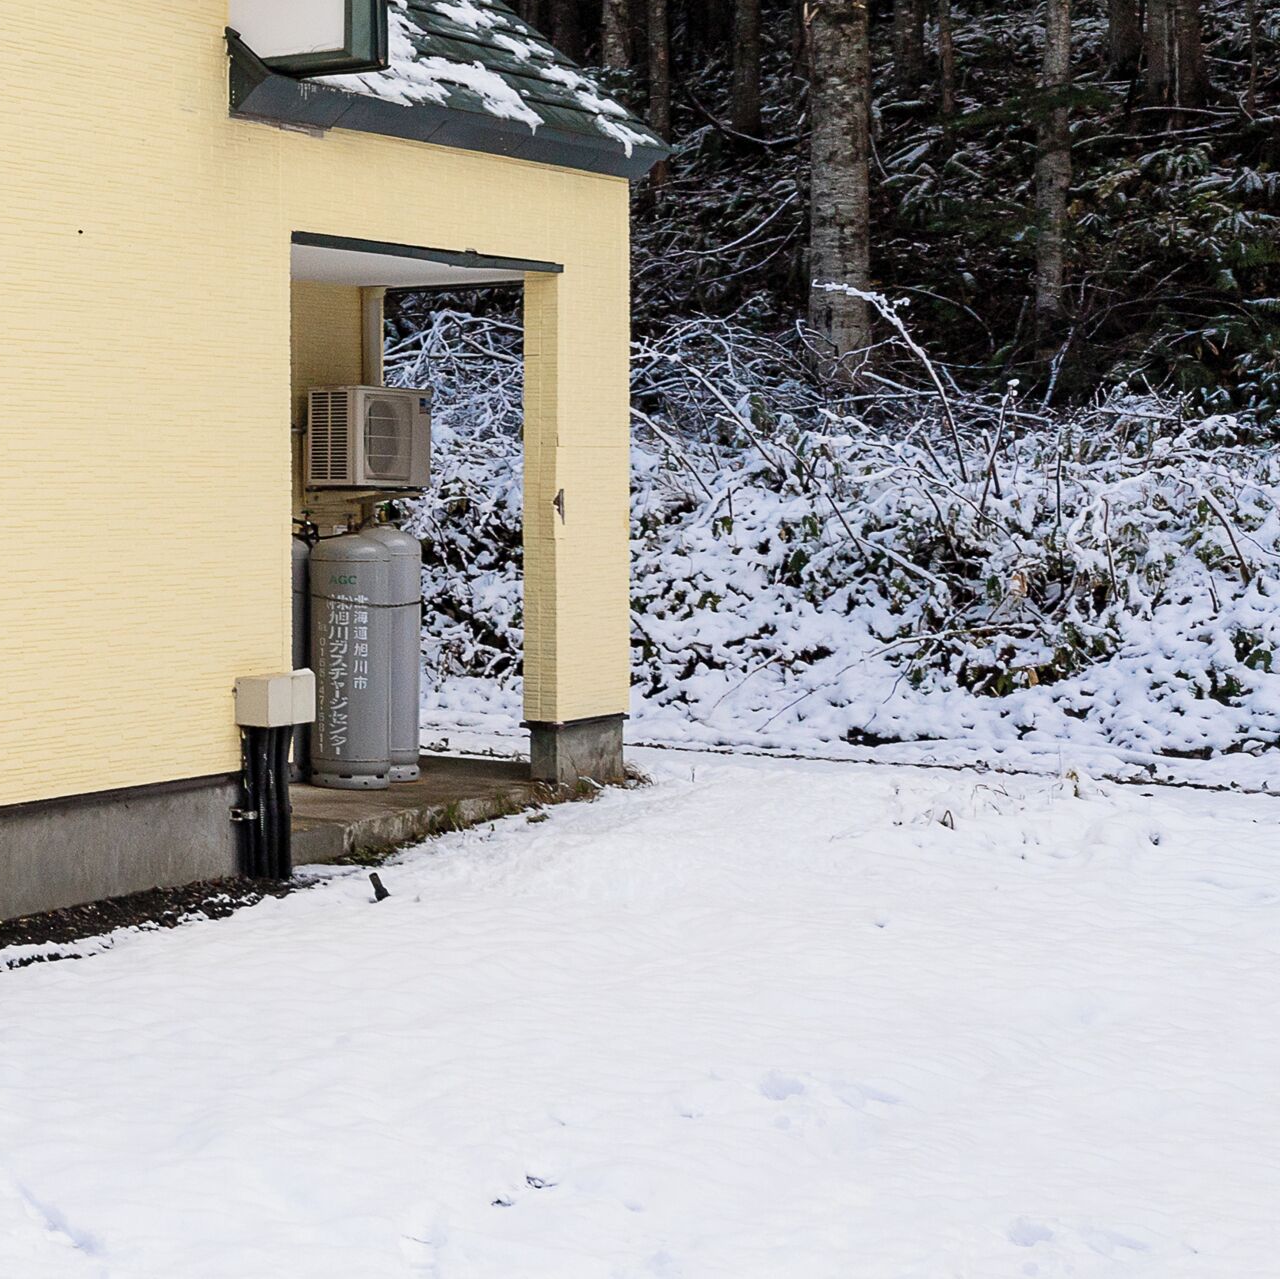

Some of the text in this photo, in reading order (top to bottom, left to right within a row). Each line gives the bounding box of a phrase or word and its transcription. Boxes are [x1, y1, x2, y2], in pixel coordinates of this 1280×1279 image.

[329, 575, 357, 585] AGC
[354, 595, 368, 690] 北海道旭川市
